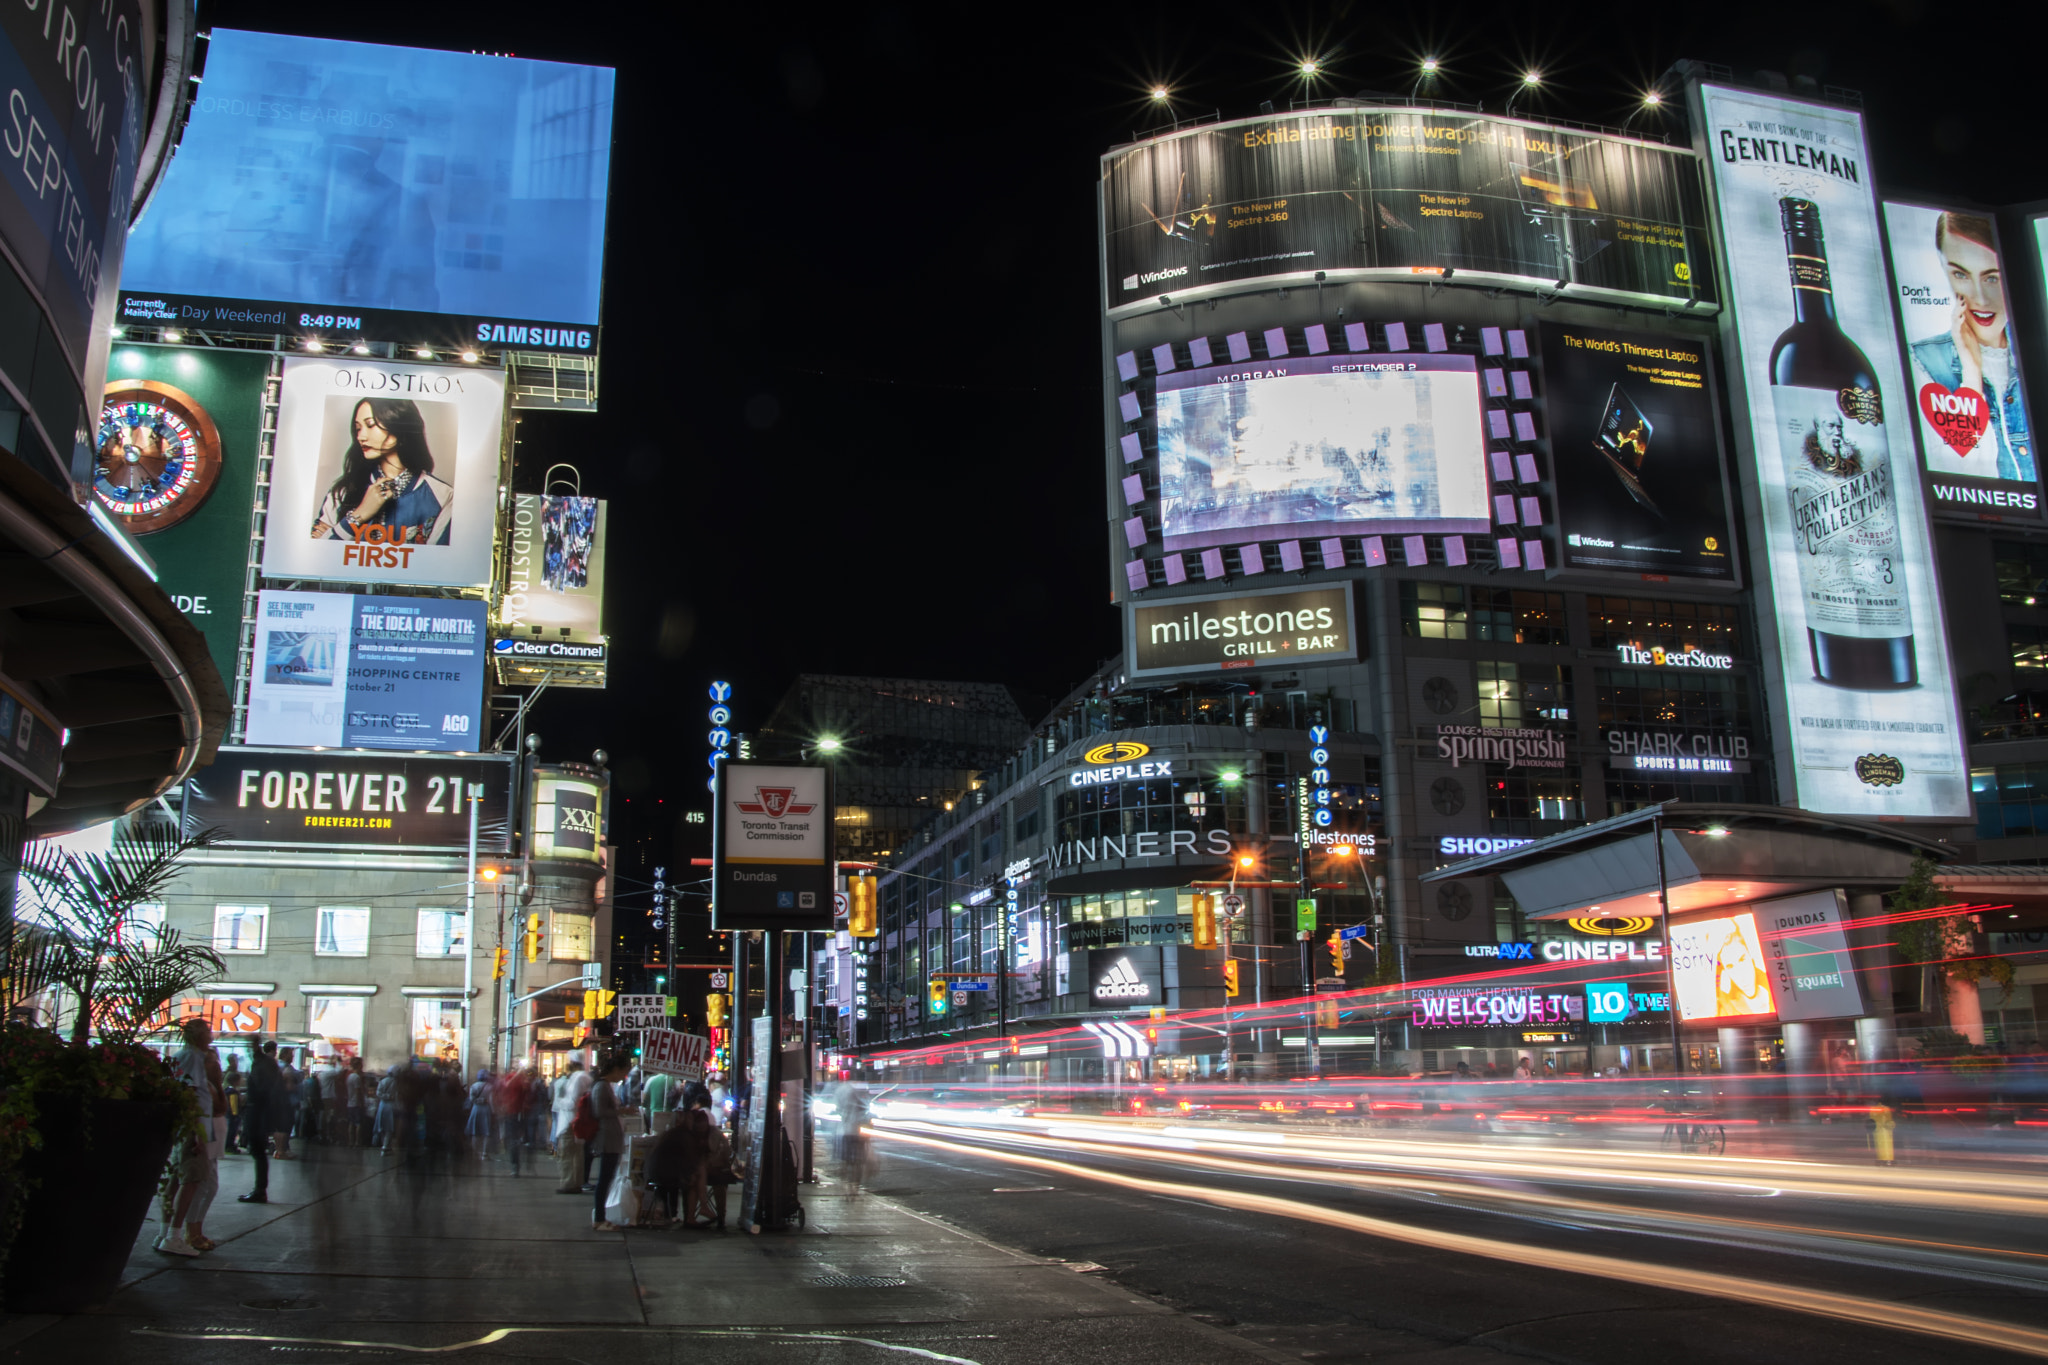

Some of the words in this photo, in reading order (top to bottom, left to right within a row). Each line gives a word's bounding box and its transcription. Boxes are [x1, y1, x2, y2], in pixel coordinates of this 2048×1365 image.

[1243, 122, 1356, 149] Exhilarating
[1361, 124, 1418, 141] power
[1422, 124, 1497, 147] wrapped
[1500, 130, 1518, 148] in
[1520, 133, 1573, 160] luxury
[1746, 120, 1762, 133] WHY
[1763, 123, 1778, 135] NOT
[1778, 124, 1800, 139] BRING
[1799, 129, 1814, 142] OUT
[1814, 132, 1828, 145] THE
[1374, 142, 1413, 154] Reinvent
[1415, 144, 1462, 156] Obsession
[1720, 129, 1860, 184] GENTLEMAN
[1231, 205, 1250, 215] The
[1252, 203, 1272, 213] New
[1273, 200, 1288, 209] HP
[1418, 194, 1436, 204] The
[1437, 196, 1456, 205] New
[1457, 197, 1471, 206] HP
[1227, 216, 1263, 229] Spectre
[1264, 212, 1289, 223] x360
[1420, 206, 1453, 217] Spectre
[1454, 209, 1485, 220] Laptop
[1616, 219, 1631, 229] The
[1632, 222, 1650, 232] New
[1651, 225, 1662, 234] HP
[1663, 227, 1684, 237] ENVY
[1617, 231, 1645, 243] Curved
[1646, 236, 1686, 249] All-in-One
[1140, 266, 1189, 285] Windows
[1901, 285, 1932, 297] Don't
[125, 298, 166, 309] Currently
[1910, 297, 1932, 305] miss
[1932, 296, 1951, 306] out!
[124, 308, 153, 319] Mainly
[154, 310, 178, 320] Clear
[182, 304, 210, 321] Day
[214, 307, 287, 325] Weekend!
[300, 313, 334, 328] 8:49
[336, 316, 361, 330] PM
[477, 323, 592, 349] SAMSUNG
[1563, 335, 1583, 348] The
[1584, 338, 1621, 353] World's
[1621, 342, 1664, 359] Thinnest
[1665, 349, 1699, 364] Laptop
[1217, 369, 1287, 384] MORGAN
[1331, 363, 1405, 373] SEPTEMBER
[1408, 363, 1417, 372] 2
[1626, 364, 1638, 373] The
[1638, 366, 1651, 374] New
[1660, 369, 1682, 379] Spectre
[1681, 371, 1702, 381] Laptop
[1649, 376, 1674, 386] Reinvent
[1674, 379, 1703, 389] Obsession
[1929, 392, 1978, 416] NOW
[1934, 411, 1982, 431] OPEN!
[1943, 427, 1973, 438] YONGE
[1943, 436, 1980, 449] DUNDAS
[1791, 463, 1887, 532] GENTLEMANS
[1932, 484, 2038, 510] WINNERS
[1806, 487, 1888, 556] COLLECTION
[349, 523, 407, 546] YOU
[1848, 534, 1894, 547] SAUVIGNON
[1857, 526, 1894, 540] CABERNET
[1581, 537, 1615, 548] Windows
[343, 545, 415, 569] FIRST
[510, 494, 534, 628] NORDSTROM
[1881, 557, 1894, 585] 3
[1866, 598, 1899, 607] HONEST
[361, 614, 384, 630] THE
[385, 615, 413, 631] IDEA
[415, 616, 431, 632] OF
[432, 617, 476, 634] NORTH:
[1151, 606, 1334, 645] milestones
[514, 641, 547, 655] Clear
[550, 643, 603, 657] Channel
[1223, 640, 1276, 658] GRILL
[1296, 635, 1335, 652] BAR
[346, 667, 410, 680] SHOPPING
[412, 670, 461, 682] CENTRE
[339, 681, 381, 693] October
[384, 683, 396, 693] 21
[442, 714, 470, 733] AGO
[1800, 716, 1815, 728] WITH
[1815, 718, 1821, 728] A
[1820, 718, 1835, 729] DASH
[1437, 724, 1478, 737] LOUNGE
[1482, 726, 1545, 740] RESTAURANT
[1607, 730, 1686, 757] SHARK
[1691, 733, 1749, 759] CLUB
[1634, 756, 1677, 770] SPORTS
[1678, 758, 1701, 771] BAR
[1702, 759, 1733, 772] GRILL
[1070, 761, 1172, 786] CINEPLEX
[1310, 725, 1332, 827] Yonge
[1864, 770, 1897, 778] LINDEMAN
[238, 769, 407, 812] FOREVER
[425, 776, 463, 814] 21
[685, 812, 705, 824] 415
[1299, 777, 1310, 849] DOWNTOWN
[304, 816, 393, 829] FOREVER21.COM
[741, 820, 777, 831] Toronto
[779, 821, 810, 831] Transit
[746, 831, 804, 841] Commission
[1046, 828, 1232, 869] WINNERS
[1357, 847, 1376, 856] BAR
[733, 870, 778, 882] Dundas
[1006, 876, 1019, 936] Yonge
[1779, 911, 1827, 929] DUNDAS
[1070, 927, 1125, 941] WINNERS
[1130, 923, 1163, 936] NOW
[1164, 921, 1193, 934] OPE
[1464, 945, 1500, 957] ULTRA
[1497, 942, 1535, 960] AVX
[1542, 940, 1664, 962] CINEPLE
[1673, 953, 1714, 972] sorry
[1772, 940, 1790, 993] YONGE
[856, 940, 867, 1021] INNERS
[1796, 973, 1840, 990] SQUARE
[1095, 982, 1150, 999] adidas
[1411, 989, 1435, 1001] FOR
[1437, 987, 1483, 999] MAKING
[1485, 986, 1535, 998] HEALTHY
[621, 997, 663, 1006] FREE
[1421, 995, 1542, 1017] WELCOME
[1591, 991, 1626, 1014] 10
[179, 997, 287, 1032] FIRST
[620, 1015, 664, 1029] ISLAM
[1531, 1034, 1555, 1042] Dundas
[645, 1029, 702, 1068] HENNA
[643, 1059, 658, 1067] ART
